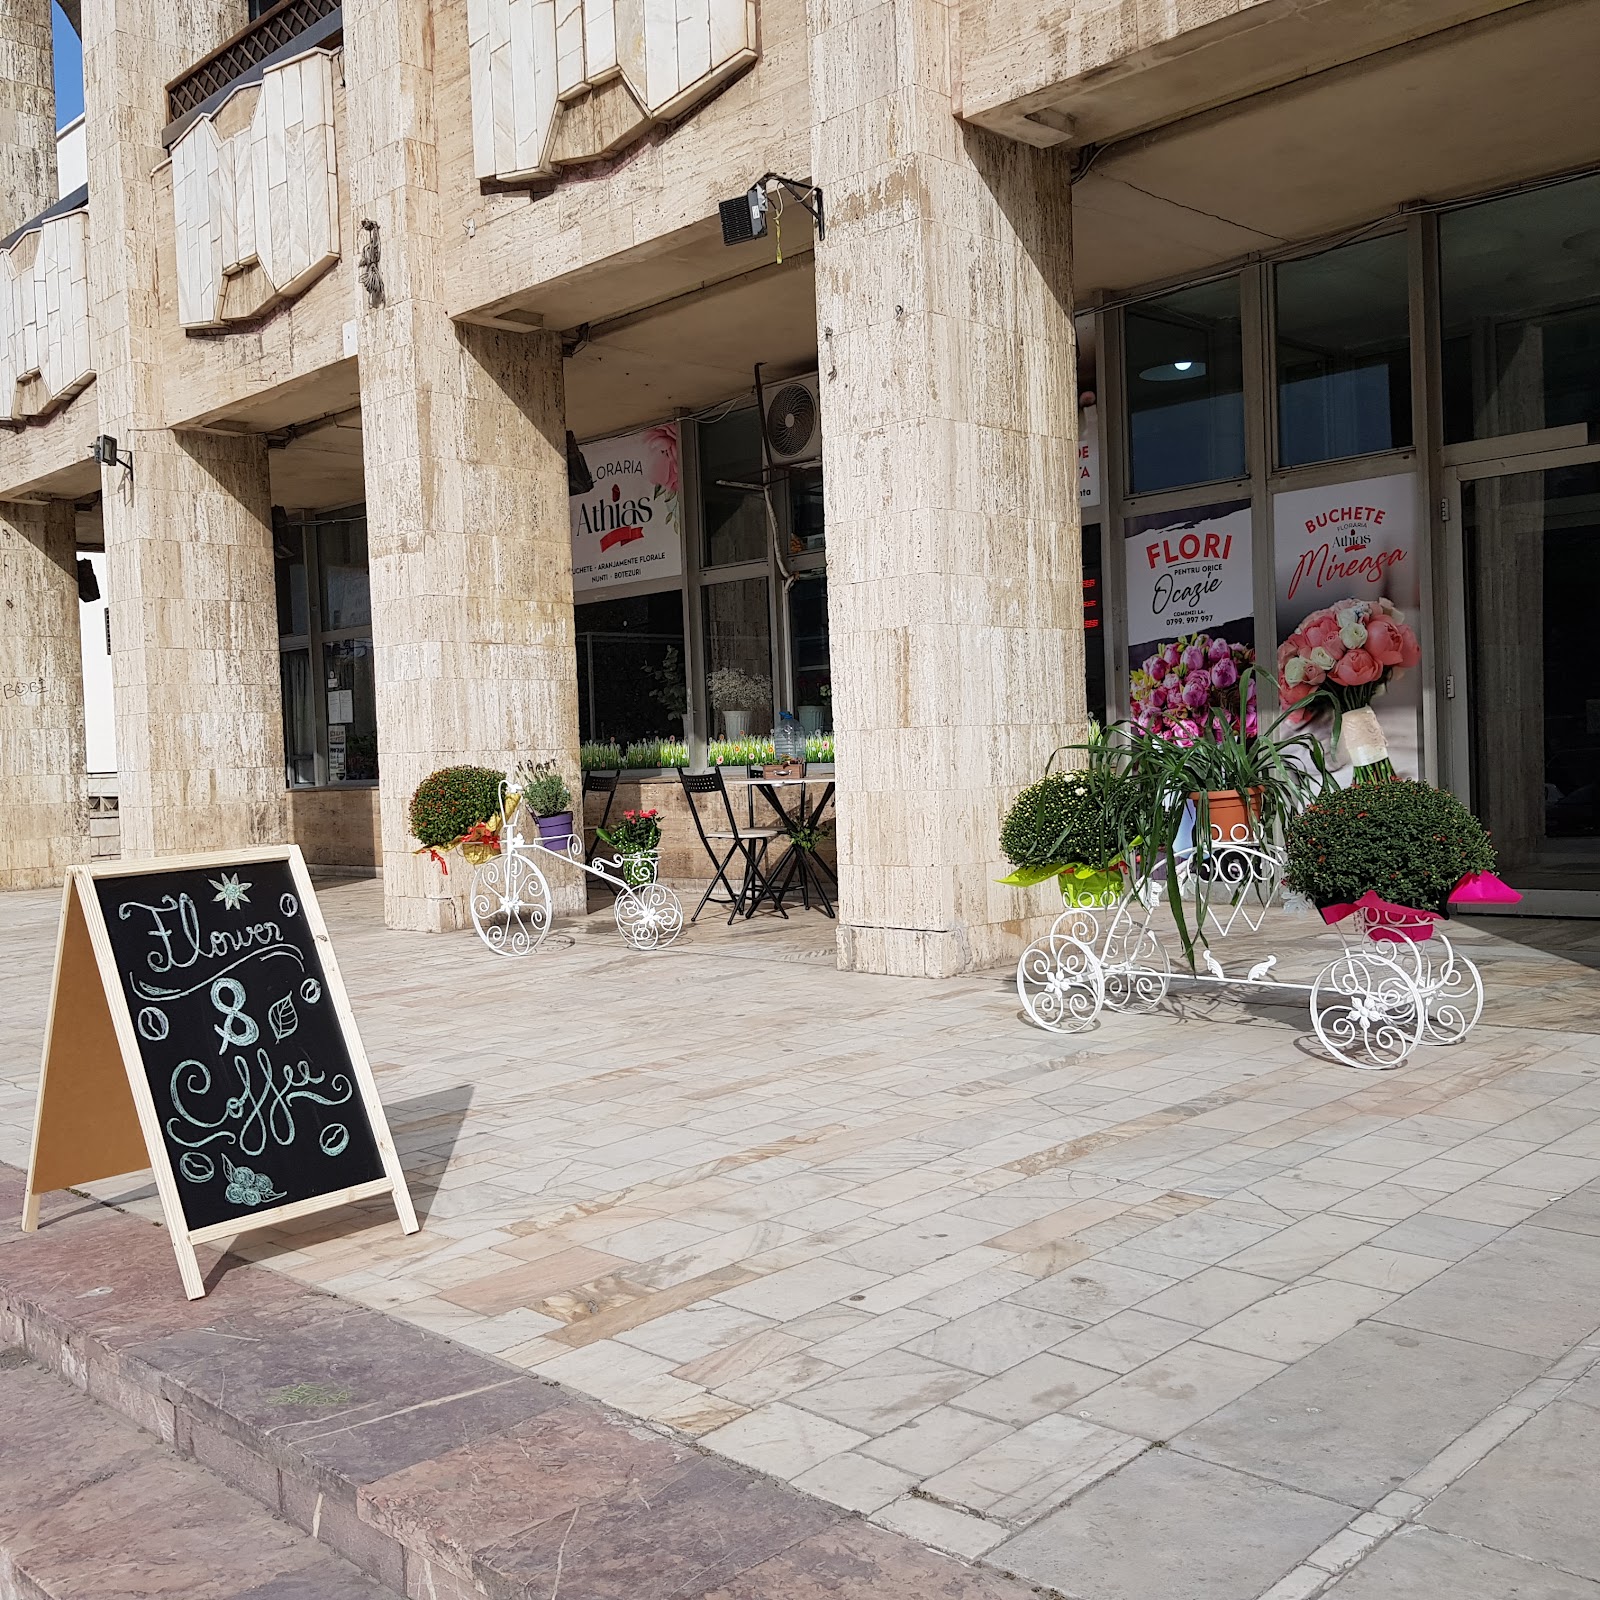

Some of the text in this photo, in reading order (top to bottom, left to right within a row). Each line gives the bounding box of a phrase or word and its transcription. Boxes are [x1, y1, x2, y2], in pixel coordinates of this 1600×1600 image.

[577, 495, 653, 536] Athias
[1305, 506, 1386, 533] BUCHETE
[1337, 522, 1368, 532] FLORARIA
[1146, 533, 1232, 569] FLORI
[1332, 534, 1371, 548] Athias
[573, 552, 666, 575] UCHETE ARANJAMENTE FLORALE
[614, 568, 642, 580] BOTEZURI
[1174, 564, 1223, 576] PENTRU ORICE
[1288, 543, 1408, 600] Mireasa
[1152, 572, 1223, 614] Ocazie
[119, 892, 283, 972] Flower
[170, 1047, 326, 1157] Coffee
